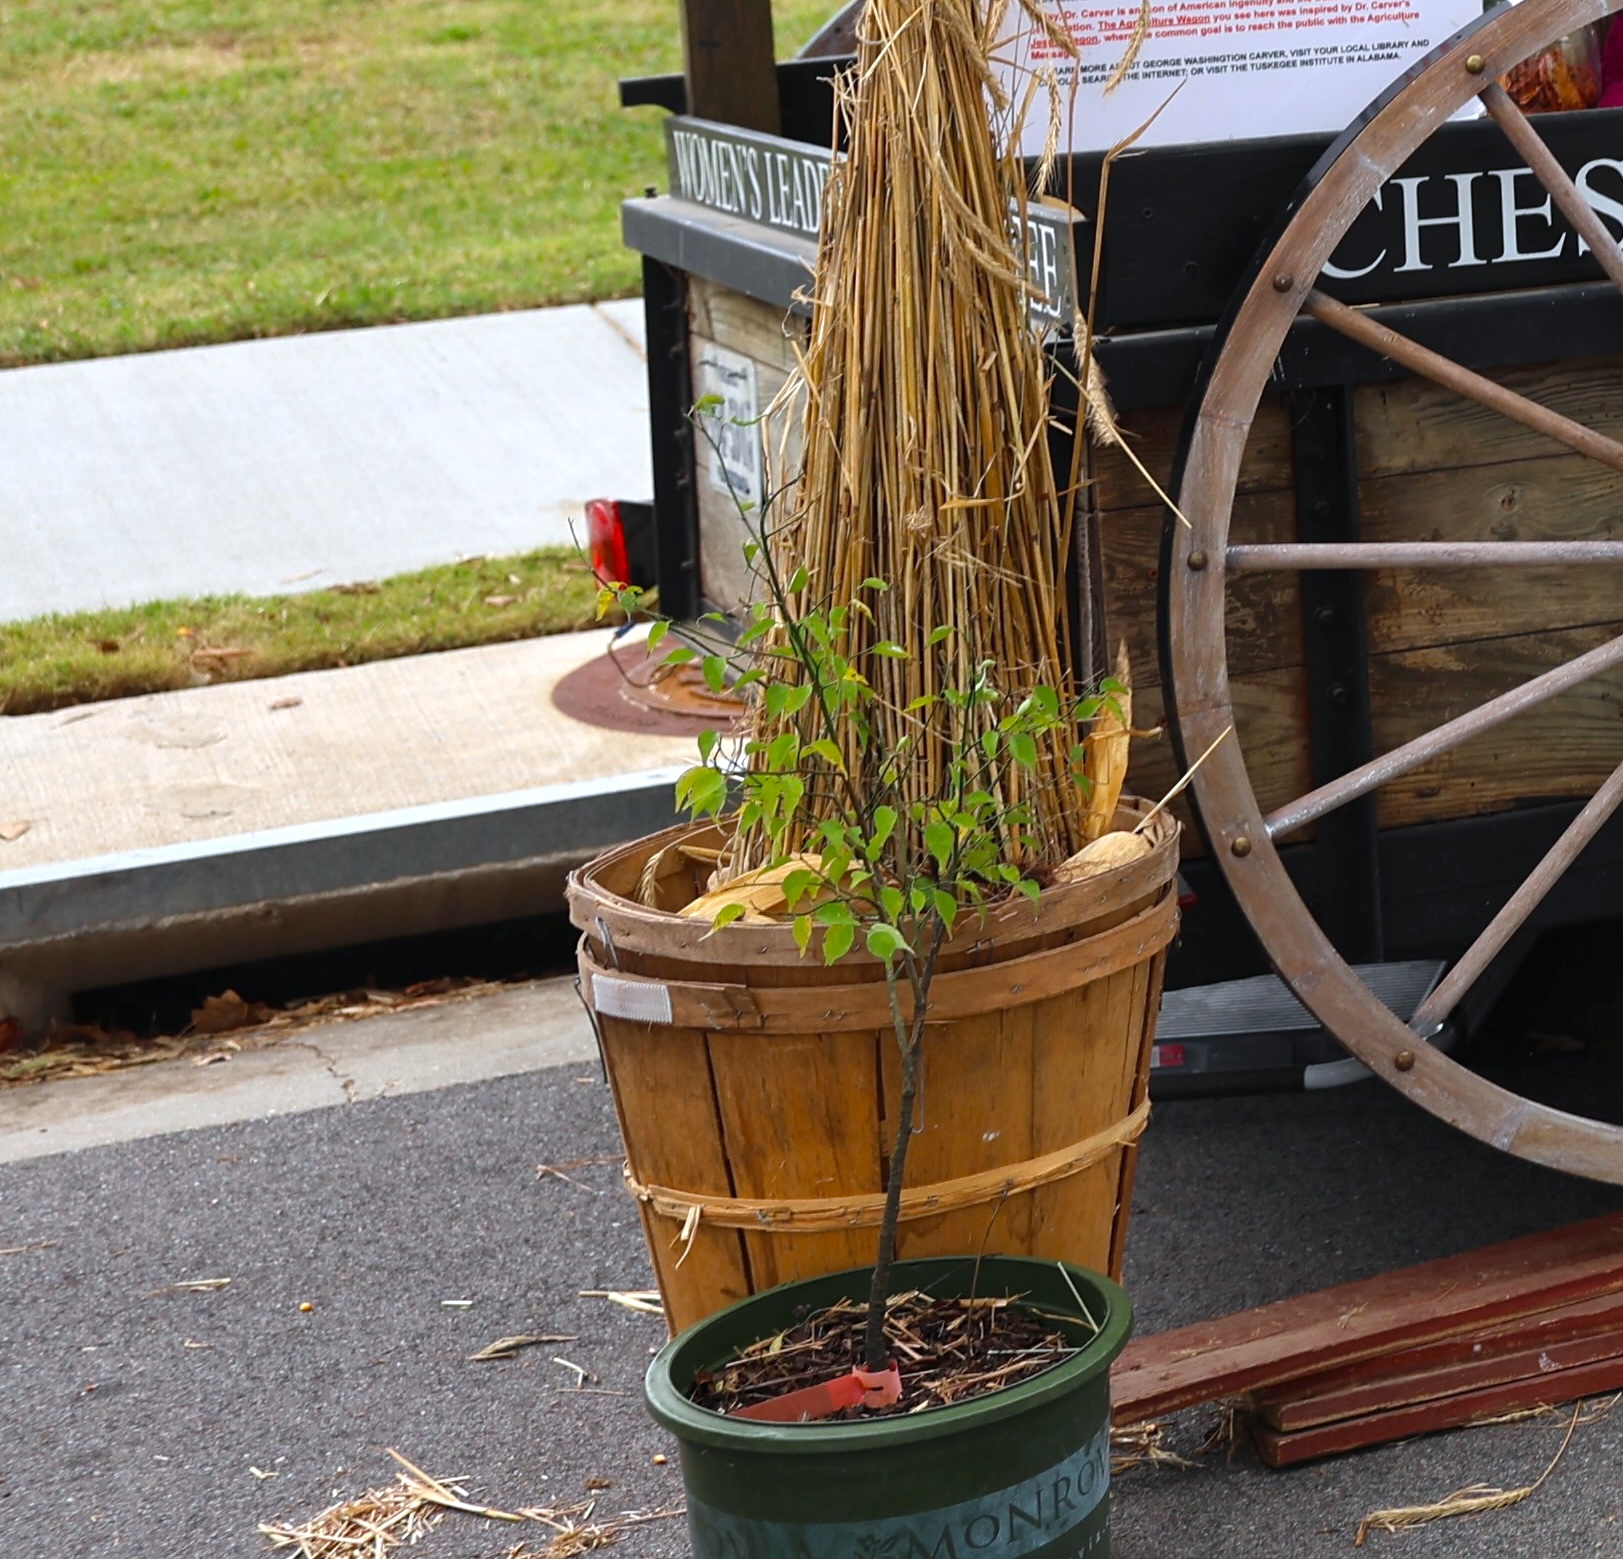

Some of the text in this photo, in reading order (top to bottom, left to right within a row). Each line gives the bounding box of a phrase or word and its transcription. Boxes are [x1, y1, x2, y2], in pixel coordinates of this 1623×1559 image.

[1081, 8, 1113, 18] Carver
[1117, 7, 1124, 15] is
[1167, 3, 1177, 11] of
[1179, 0, 1225, 11] American
[1098, 20, 1117, 30] The
[1177, 13, 1210, 26] Wagon
[1213, 13, 1231, 23] you
[1234, 10, 1250, 19] see
[1253, 8, 1274, 17] here
[1278, 8, 1296, 16] was
[1299, 3, 1338, 16] inspired
[1341, 2, 1352, 12] by
[1355, 1, 1368, 10] Dr.
[1154, 10, 1419, 37] common goal is to reach the public with the Agriculture
[1080, 64, 1106, 72] MORE
[1143, 58, 1181, 68] GEORGE
[1249, 50, 1288, 60] CARVER,
[1290, 48, 1311, 56] VISIT
[1314, 46, 1337, 55] YOUR
[1341, 44, 1369, 53] LOCAL
[1372, 40, 1409, 50] LIBRARY
[1410, 39, 1429, 47] AND
[1190, 67, 1203, 75] OR
[1205, 65, 1228, 74] VISIT
[1230, 63, 1247, 72] THE
[1250, 59, 1296, 70] TUSKEGEE
[1300, 56, 1343, 66] INSTITUTE
[1356, 52, 1401, 62] ALABAMA.
[673, 130, 762, 220] WOMEN'S
